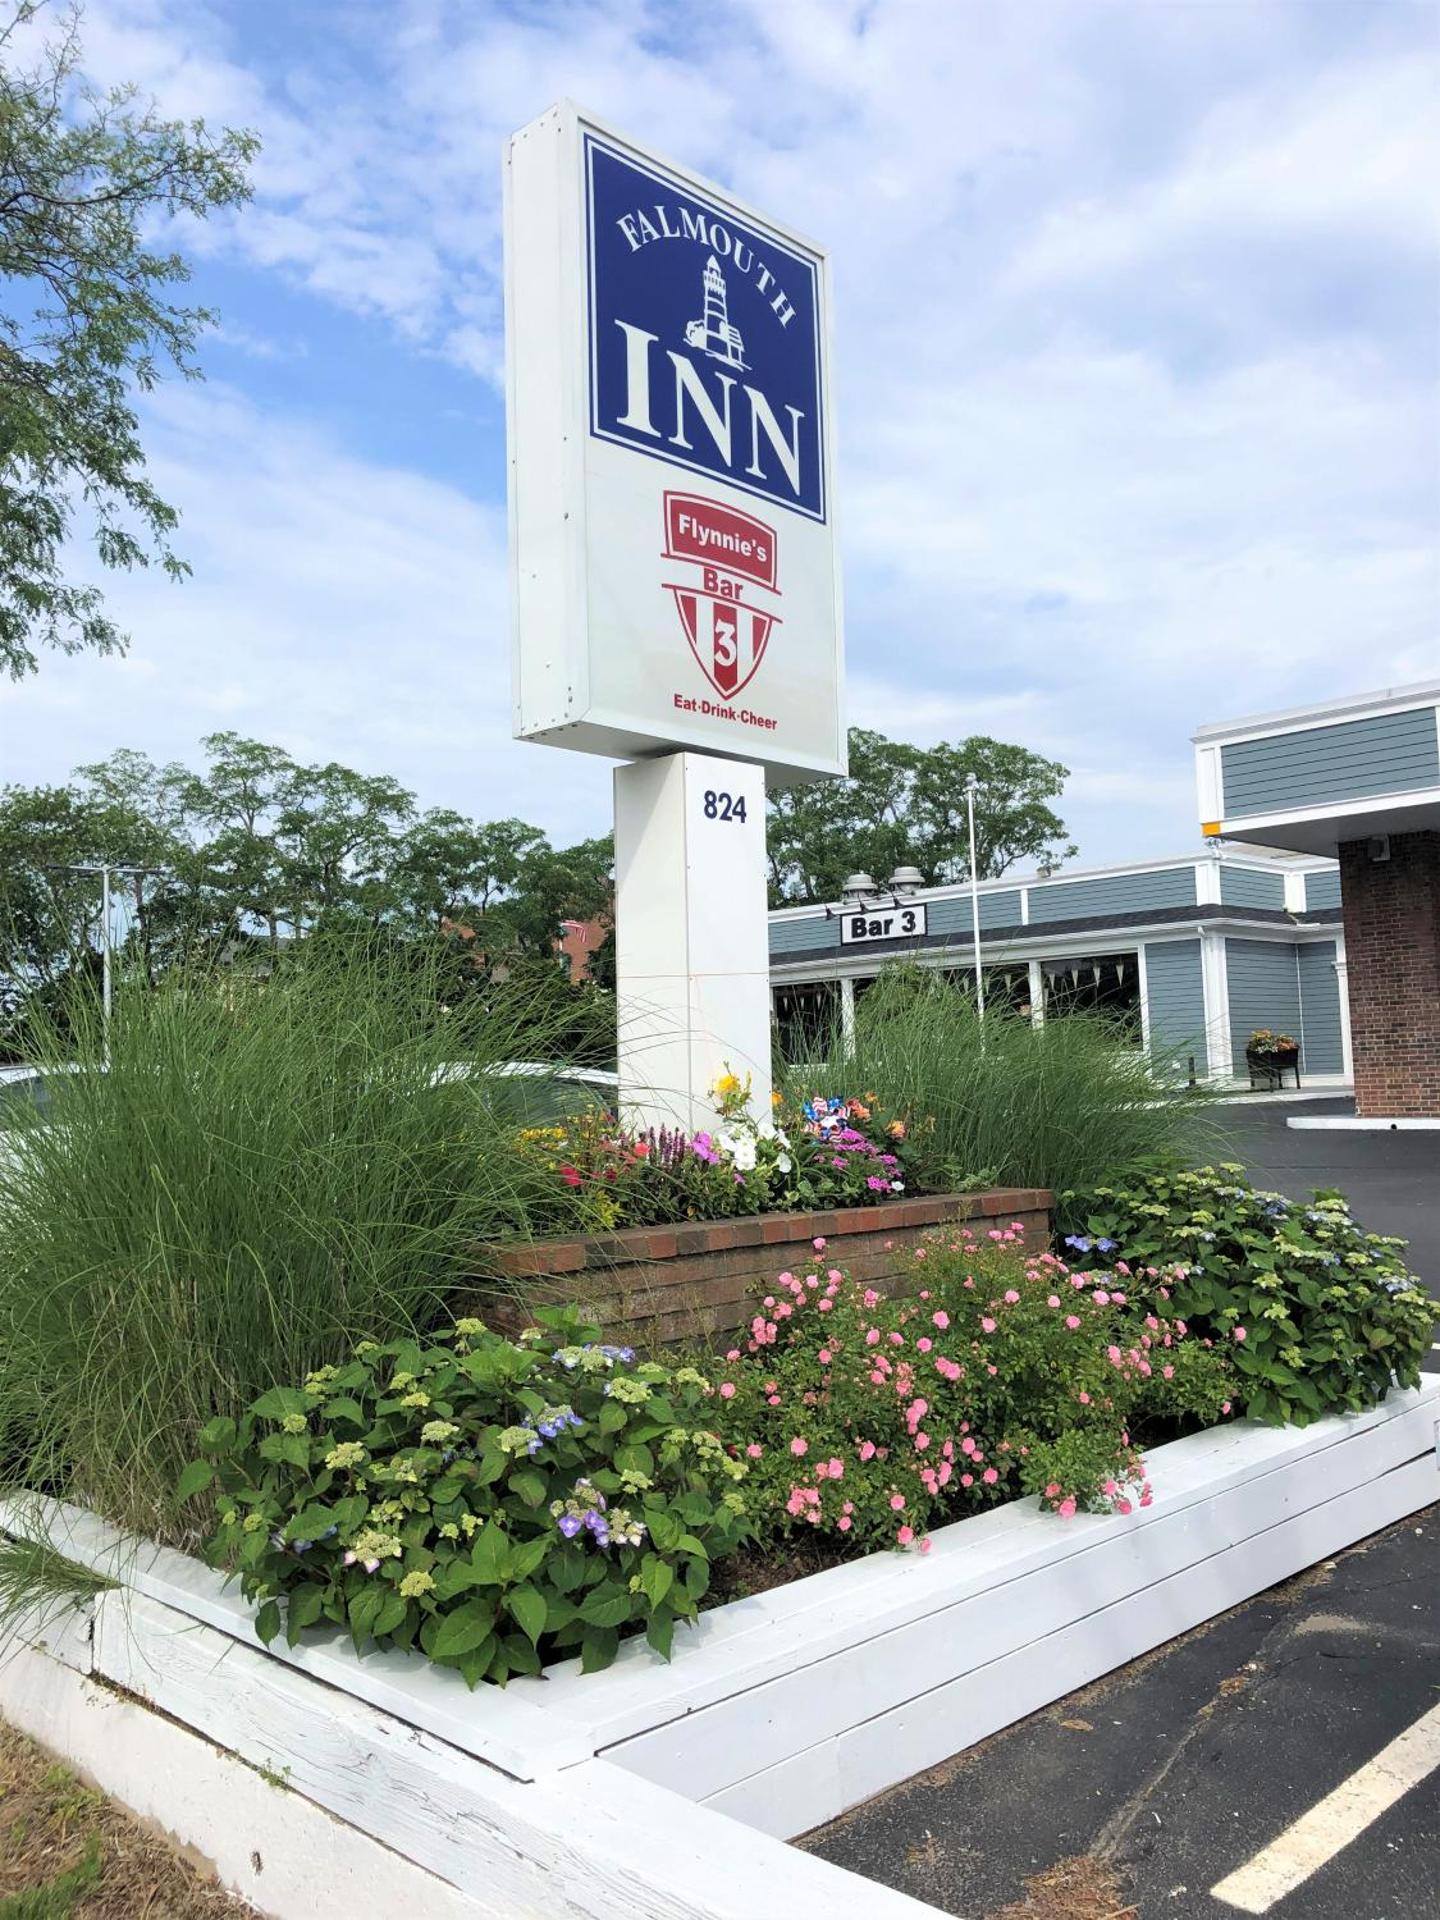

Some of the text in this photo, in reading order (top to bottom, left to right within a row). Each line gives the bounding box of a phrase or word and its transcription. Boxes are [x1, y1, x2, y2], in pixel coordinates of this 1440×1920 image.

[616, 205, 796, 328] FALMOUTH
[614, 319, 805, 497] INN
[678, 514, 768, 562] Flynnie's
[704, 568, 744, 600] Bar
[714, 618, 737, 667] 3
[703, 789, 747, 823] 824
[851, 910, 916, 938] Bar 3
